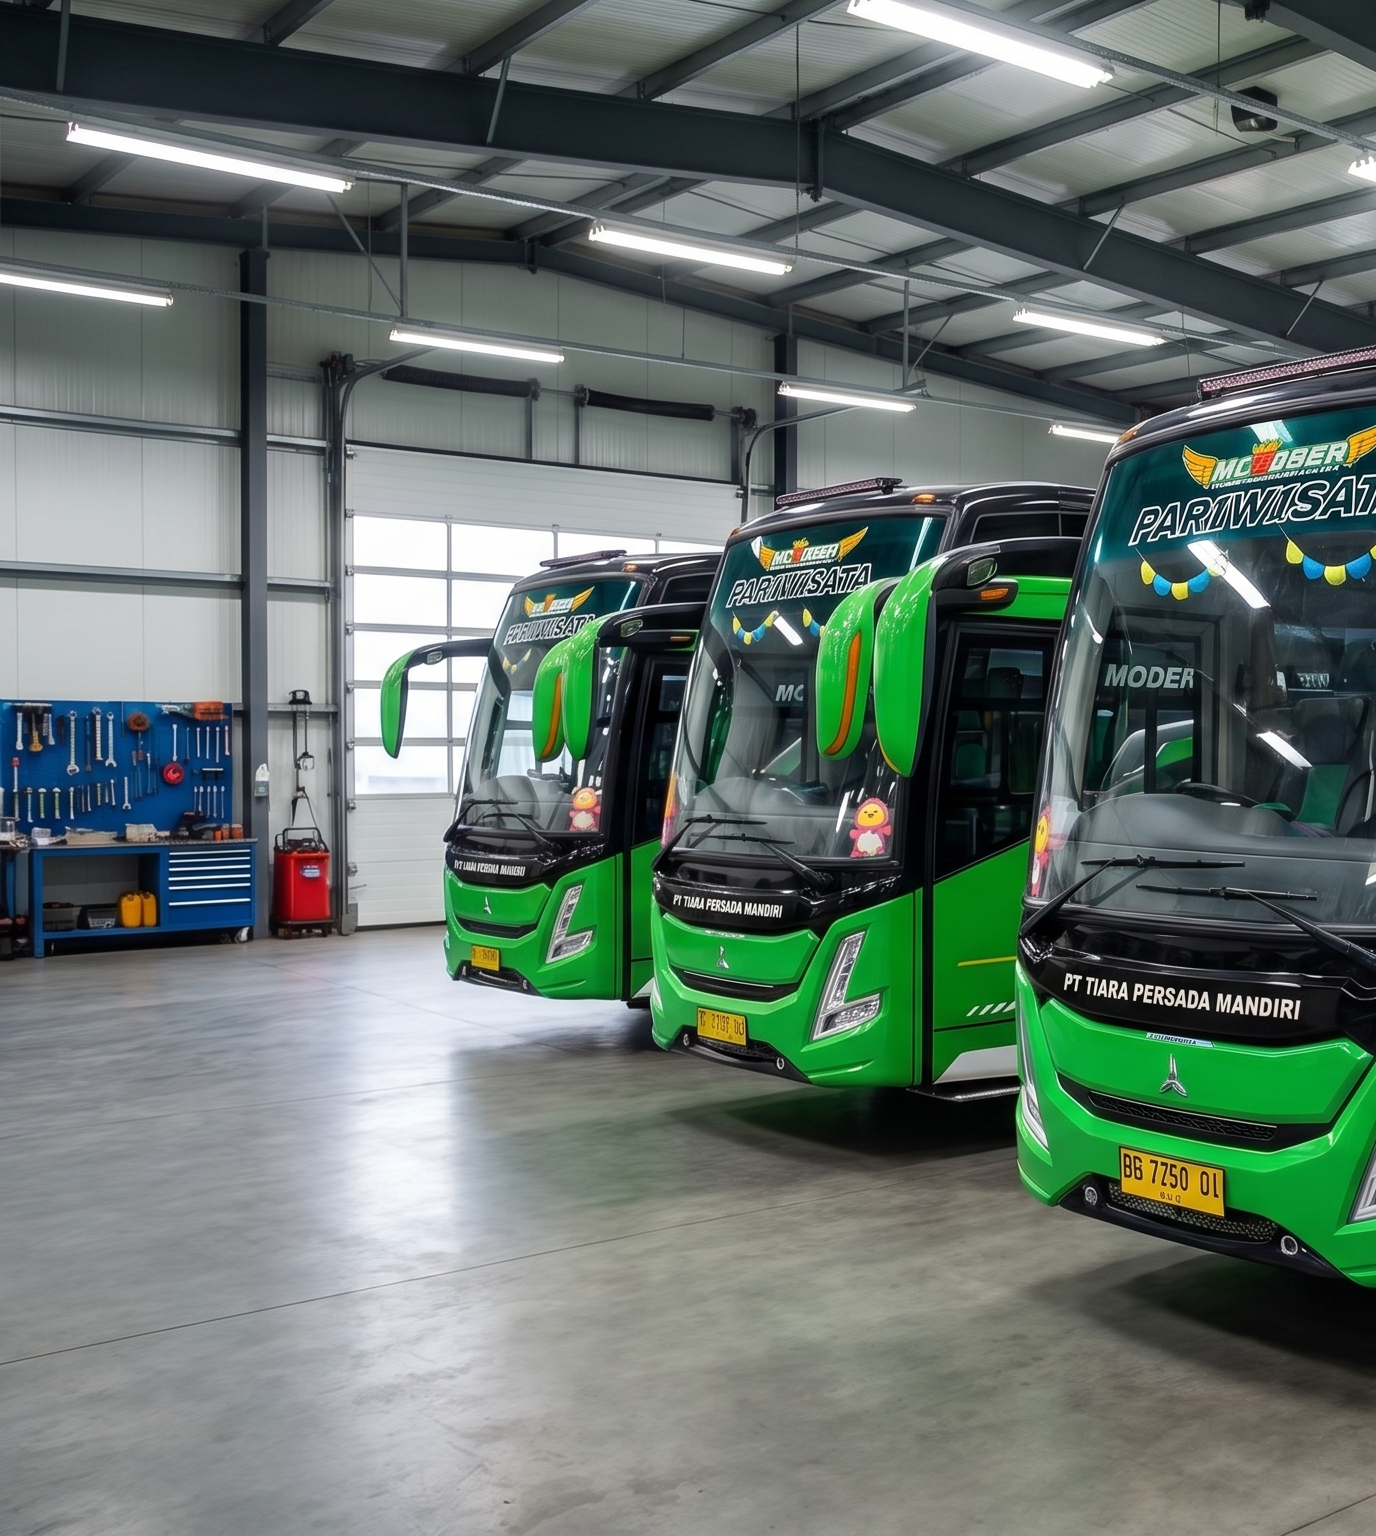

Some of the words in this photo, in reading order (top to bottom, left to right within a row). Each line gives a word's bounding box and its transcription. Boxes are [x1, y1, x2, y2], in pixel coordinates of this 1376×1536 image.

[744, 902, 783, 919] MANDIRI
[1063, 973, 1082, 992] PT
[1086, 976, 1129, 1001] TIARA
[1133, 983, 1211, 1011] PERSADA
[1216, 993, 1301, 1020] MANDIRI
